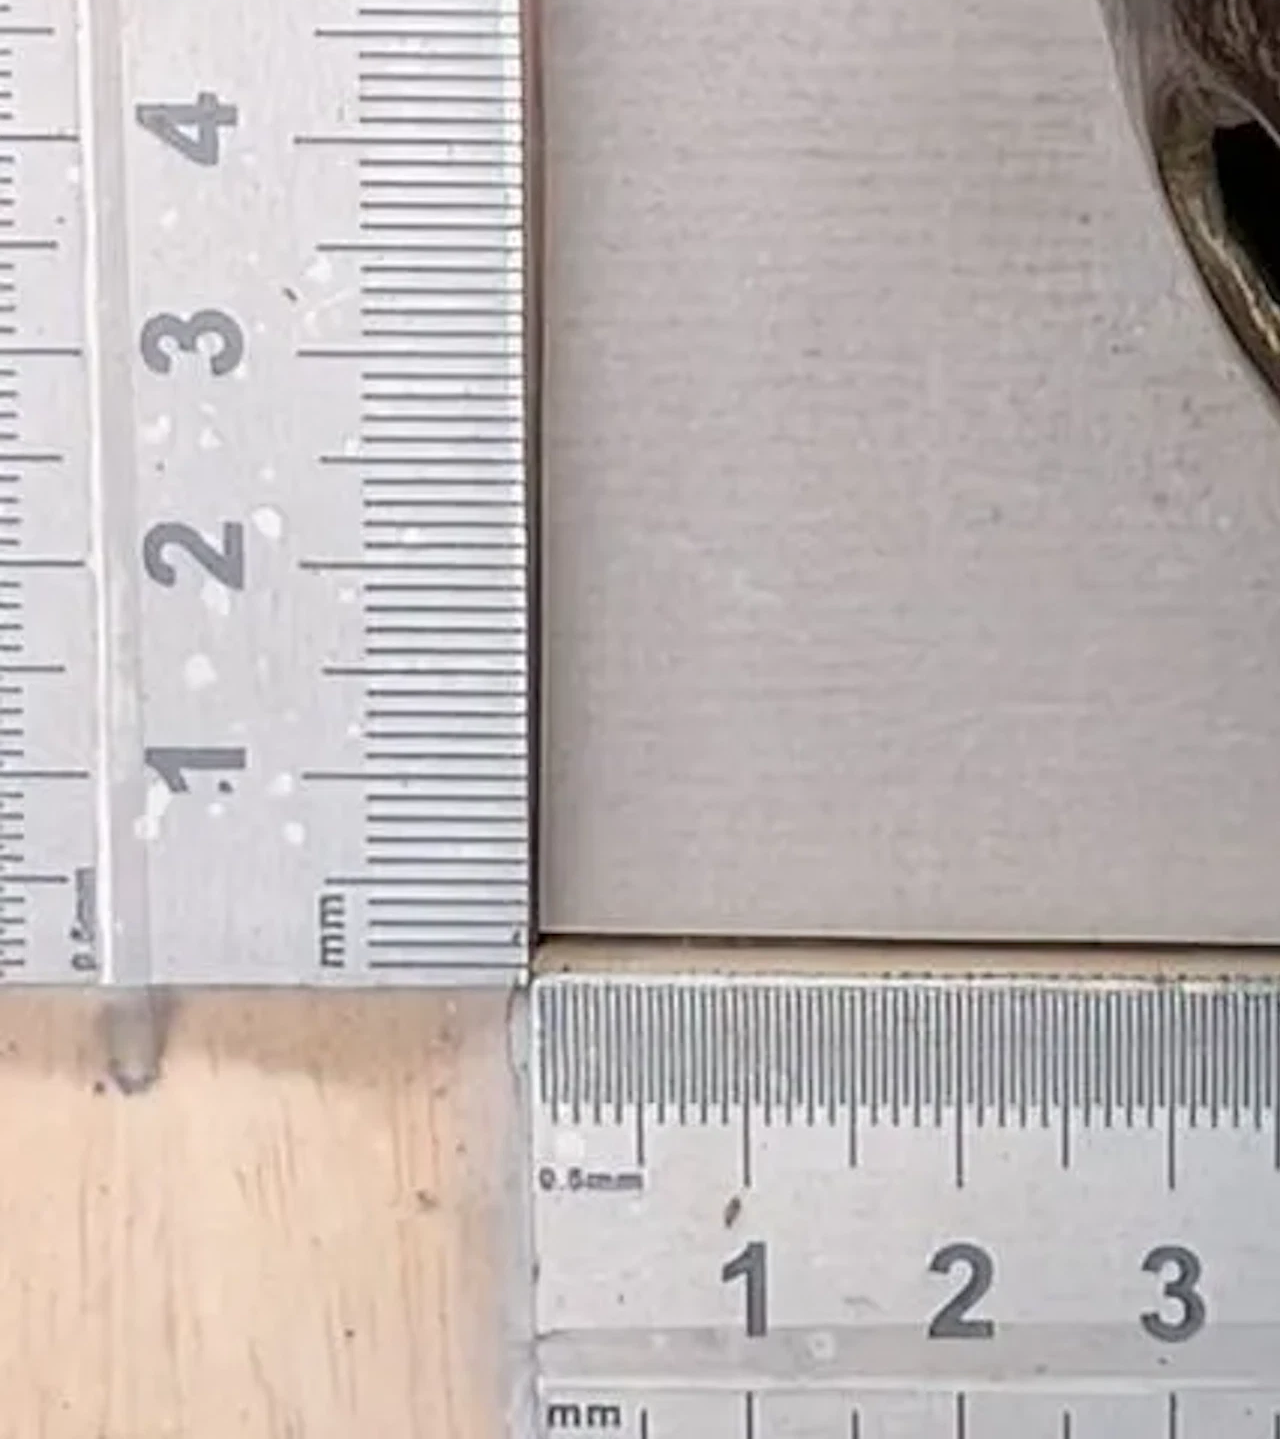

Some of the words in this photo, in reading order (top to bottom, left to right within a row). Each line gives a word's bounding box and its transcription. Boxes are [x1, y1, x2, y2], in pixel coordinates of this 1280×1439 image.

[135, 92, 238, 167] 4
[138, 309, 244, 378] 3
[141, 521, 244, 591] 2
[143, 747, 246, 793] 1
[319, 892, 346, 969] mm
[721, 1243, 768, 1339] 1
[927, 1243, 996, 1341] 2
[1139, 1245, 1207, 1343] 3
[546, 1403, 622, 1429] mm
